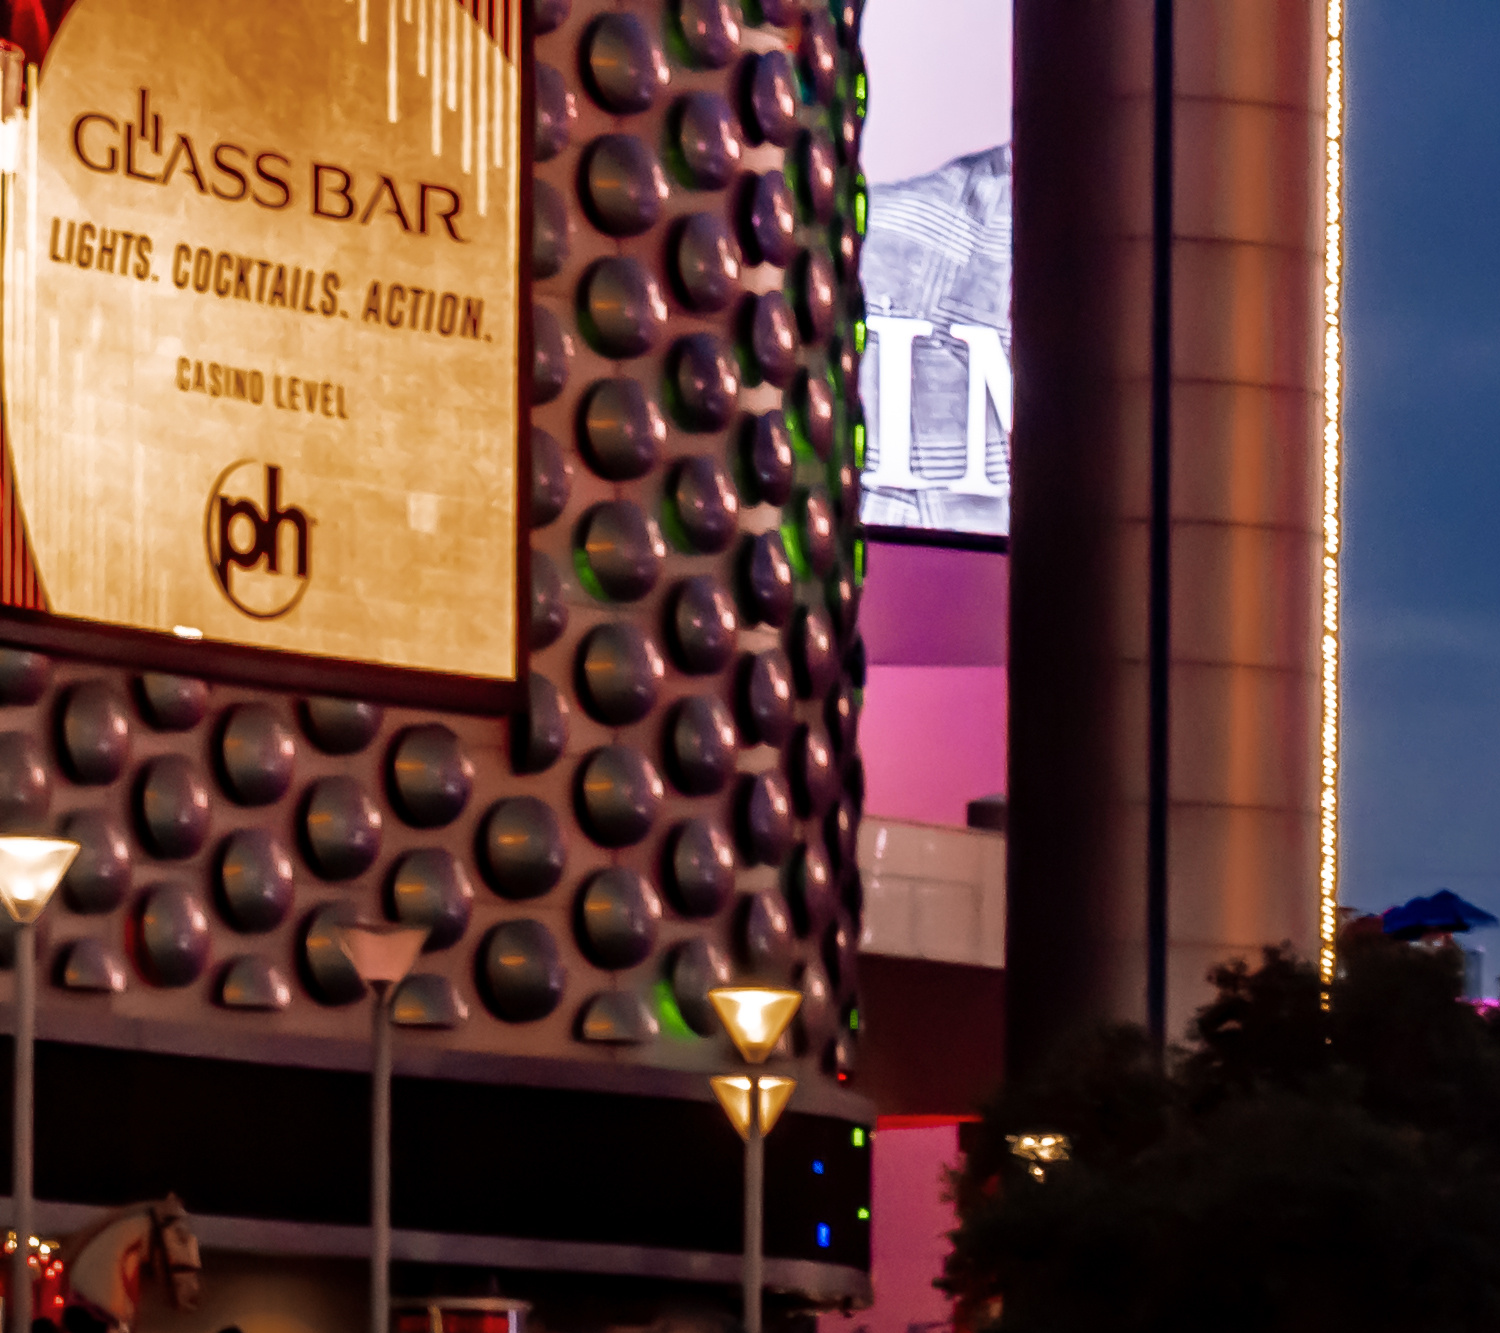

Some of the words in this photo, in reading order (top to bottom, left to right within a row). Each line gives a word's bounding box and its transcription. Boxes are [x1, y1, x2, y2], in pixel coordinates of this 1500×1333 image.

[71, 88, 292, 211] GLASS
[312, 164, 470, 243] BAR
[49, 218, 160, 284] LIGHTS.
[171, 243, 349, 320] COCKTAILS.
[363, 282, 494, 342] ACTION.
[176, 356, 265, 404] CASINO
[273, 374, 349, 421] LEVEL
